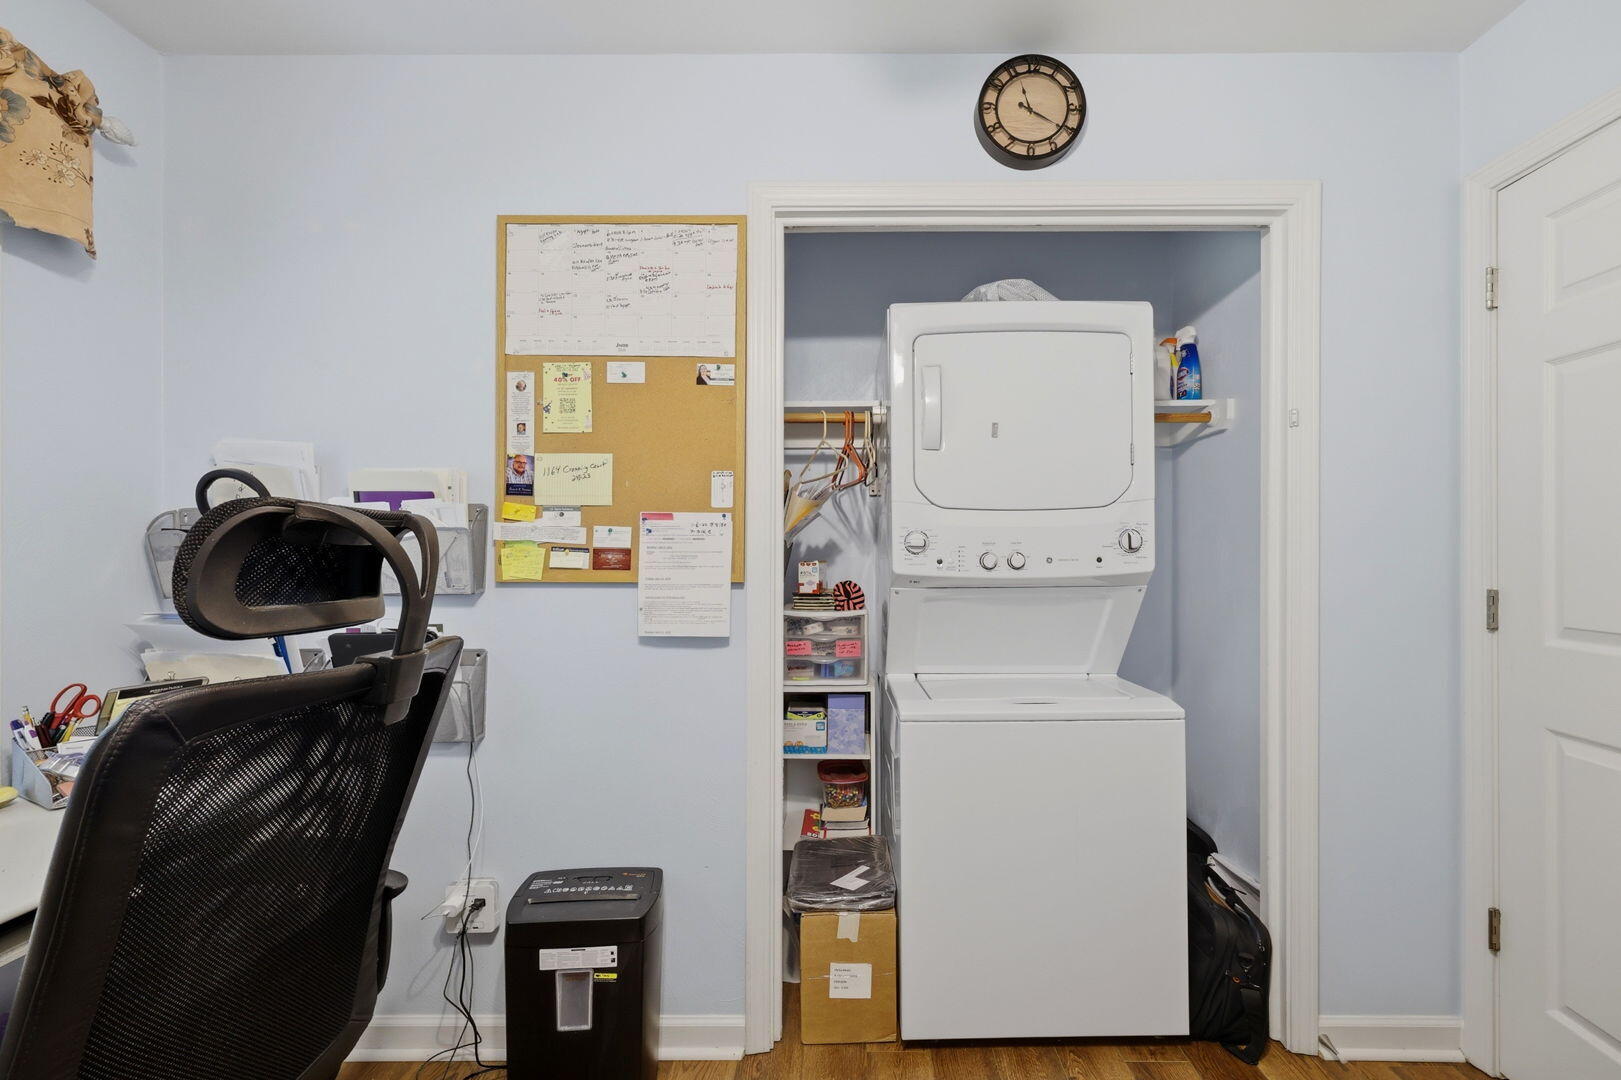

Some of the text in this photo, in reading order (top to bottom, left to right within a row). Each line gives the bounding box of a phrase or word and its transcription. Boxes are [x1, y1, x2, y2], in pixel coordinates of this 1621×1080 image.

[1027, 56, 1040, 72] 12
[1062, 81, 1078, 93] 2
[982, 101, 997, 111] 9
[1068, 102, 1083, 113] 3
[987, 121, 1001, 134] 8
[1004, 136, 1015, 149] 7
[1027, 142, 1035, 156] 6
[1049, 136, 1058, 151] 5
